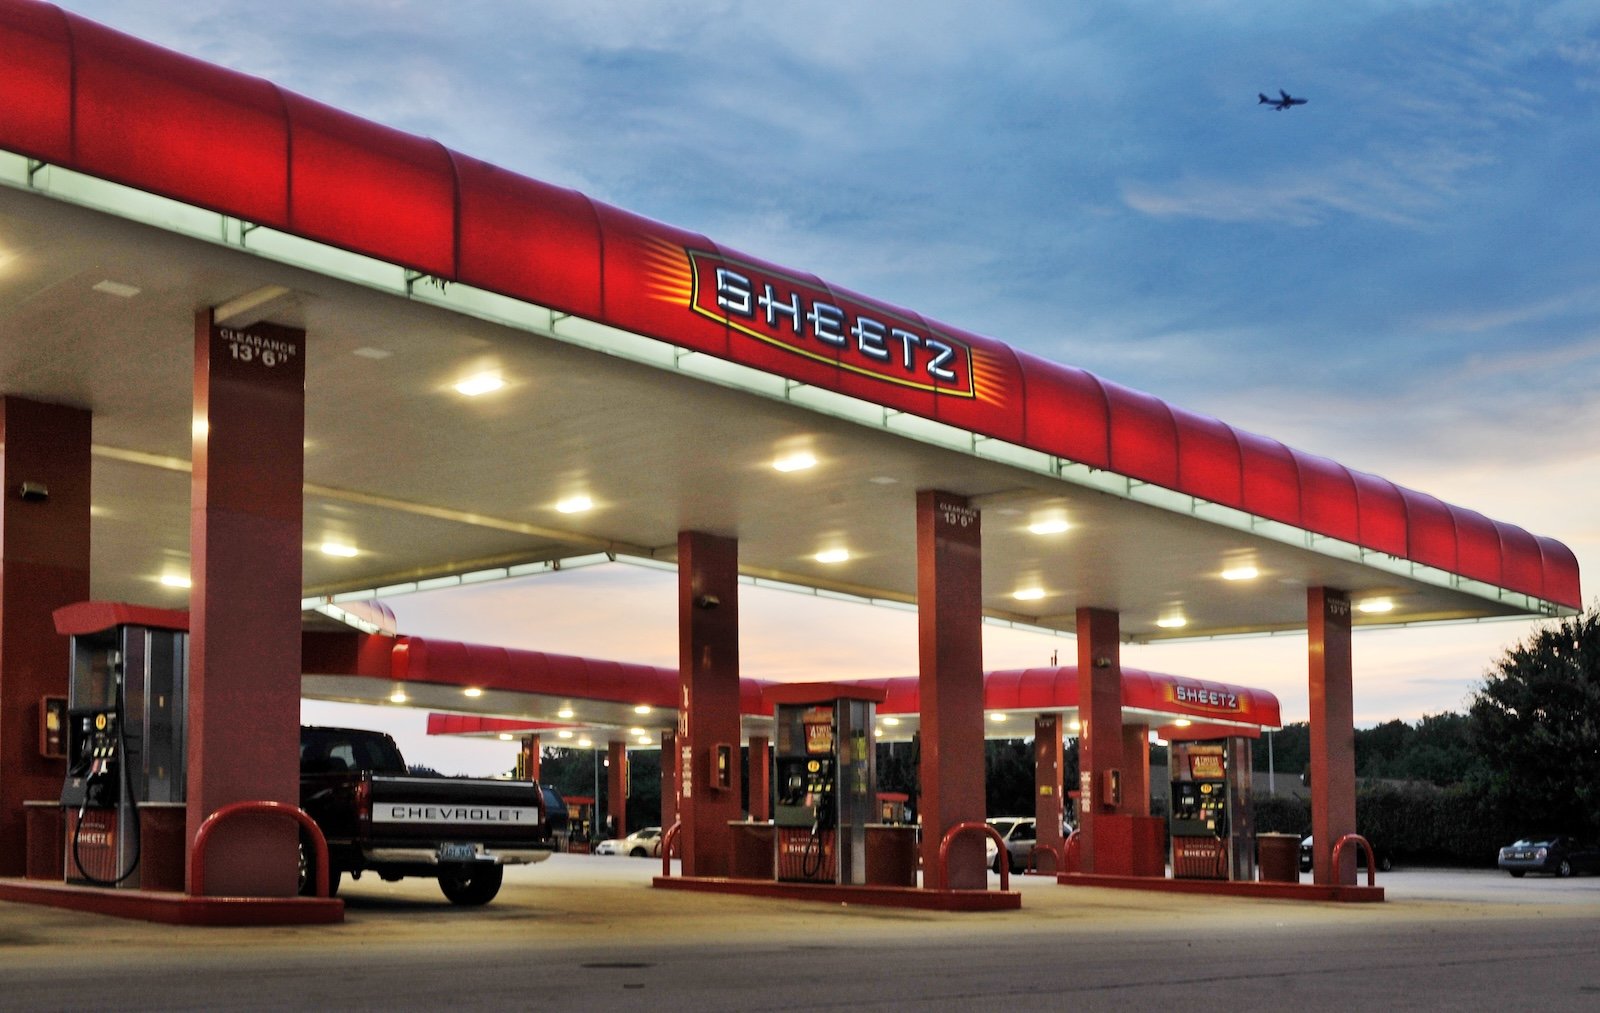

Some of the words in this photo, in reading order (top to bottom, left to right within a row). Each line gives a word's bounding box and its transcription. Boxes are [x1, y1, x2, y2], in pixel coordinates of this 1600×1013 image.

[716, 267, 955, 381] SHEETZ
[220, 328, 297, 356] CLEARANCE
[1177, 686, 1236, 708] SHEETZ
[391, 806, 523, 821] CHEVROLET
